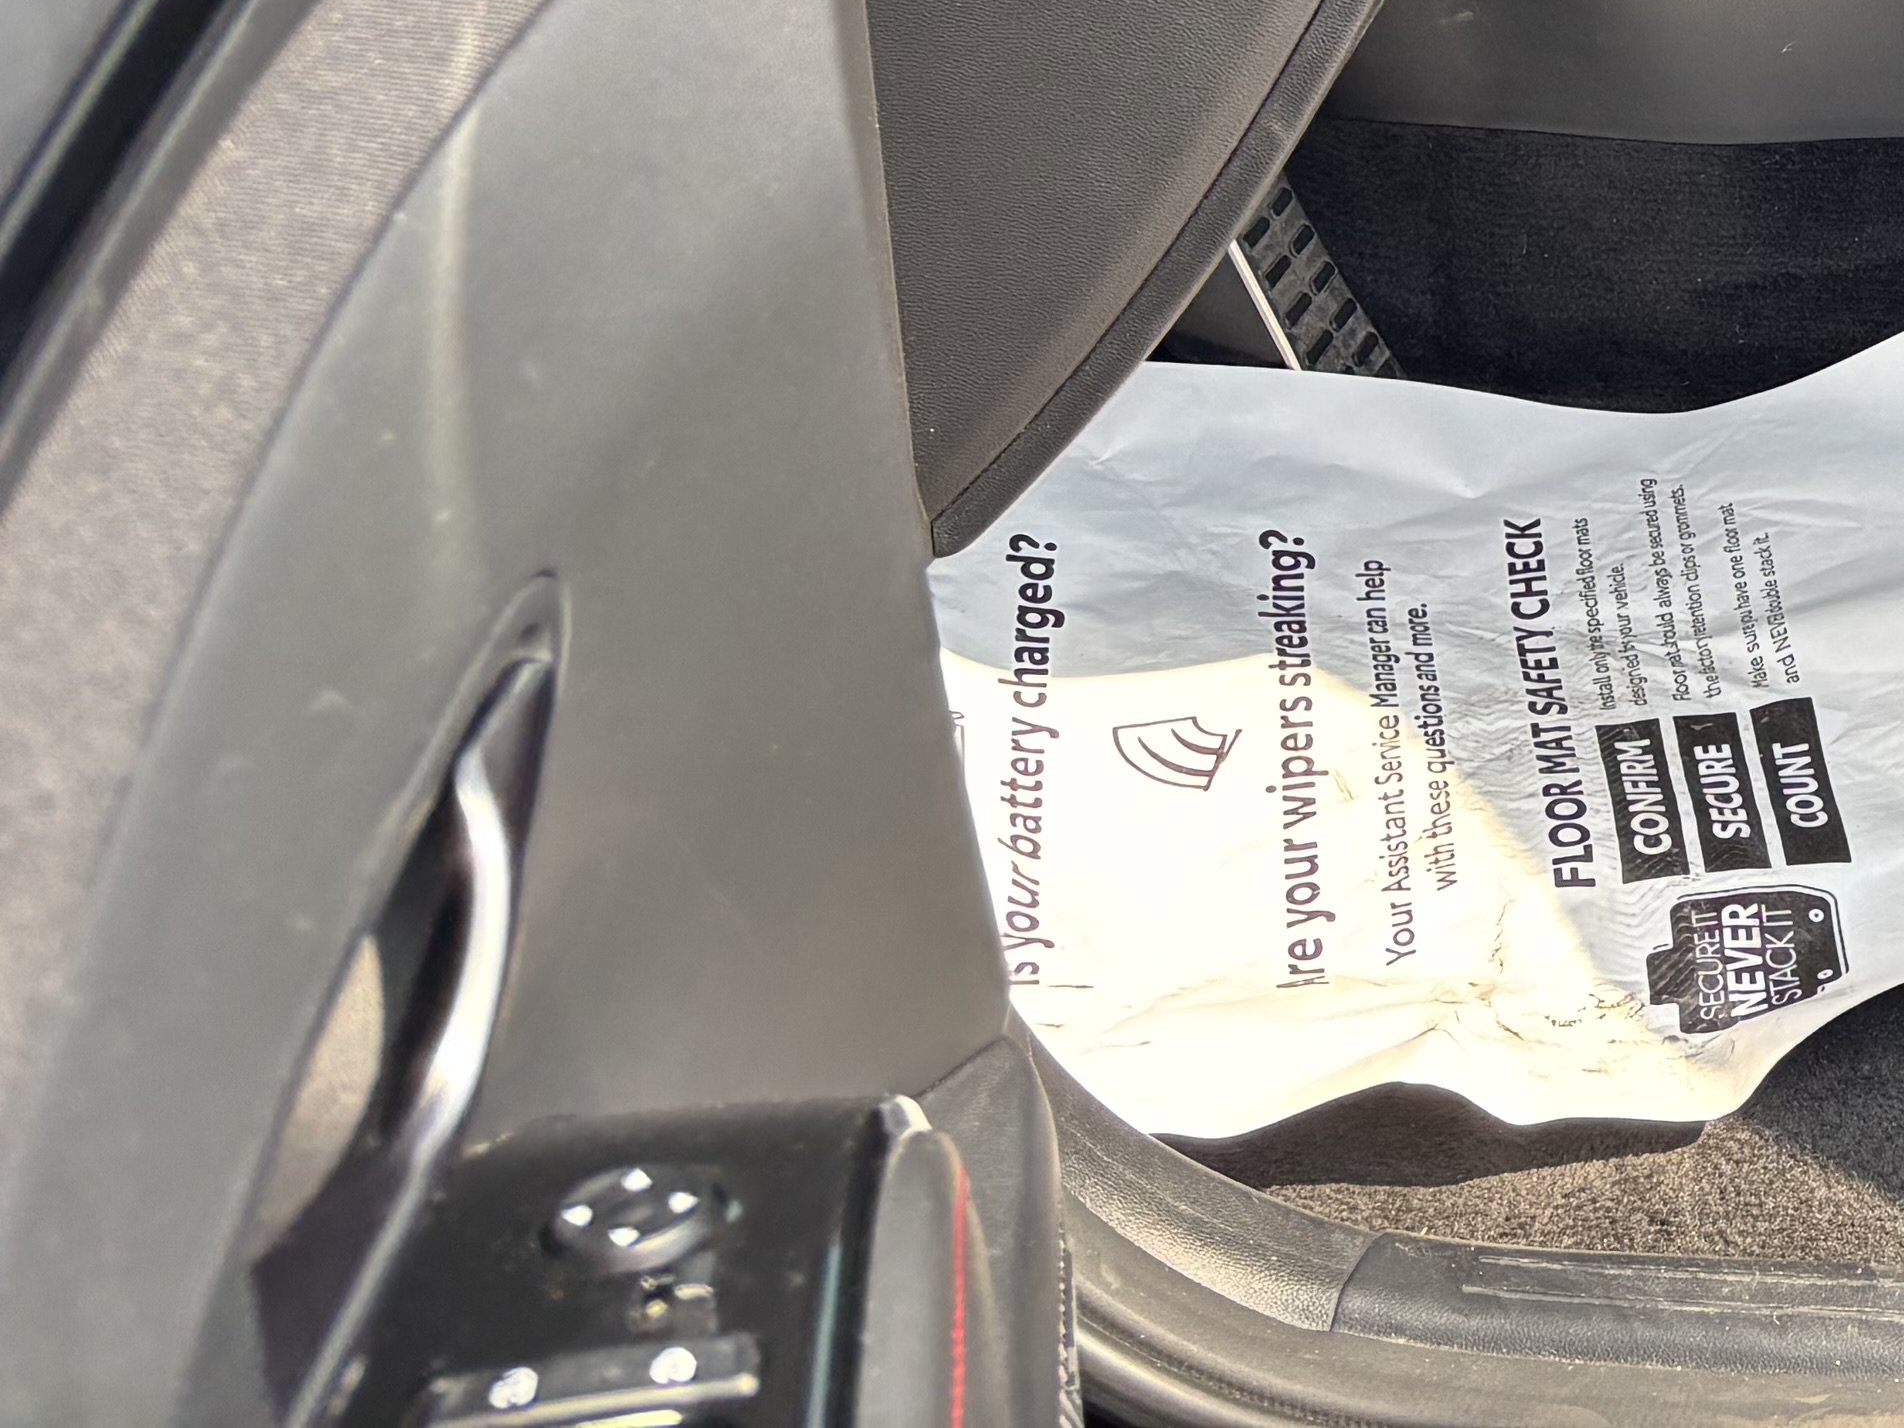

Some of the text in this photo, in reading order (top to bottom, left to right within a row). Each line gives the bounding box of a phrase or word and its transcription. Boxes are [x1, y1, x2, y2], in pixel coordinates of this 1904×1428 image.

[1637, 476, 1660, 509] using
[1716, 500, 1736, 526] mat
[1569, 516, 1592, 547] mats
[1638, 507, 1664, 551] secured
[1722, 525, 1742, 554] floor
[1574, 546, 1597, 576] floor
[1646, 549, 1667, 568] be
[1729, 553, 1747, 581] one
[1752, 544, 1777, 578] stack
[1255, 526, 1316, 689] streaking?
[1573, 573, 1608, 635] specified
[1605, 561, 1630, 611] vehicle.
[1651, 565, 1675, 610] always
[1668, 481, 1723, 700] the factory retention clips or grommets.
[1732, 580, 1753, 611] have
[1760, 577, 1785, 615] double
[995, 531, 1066, 710] charged?
[1740, 622, 1762, 653] sure
[1591, 649, 1618, 675] only
[1620, 652, 1650, 707] designed
[1665, 667, 1693, 703] Floor
[1746, 654, 1770, 690] Make
[1777, 652, 1802, 686] and
[1501, 515, 1598, 890] FLOOR MAT SAFETY CHECK
[1593, 673, 1618, 712] Install
[1263, 694, 1330, 831] wipers
[1353, 558, 1418, 967] Your Assistant Service Manager can help
[1403, 601, 1459, 892] with these questions and more.
[995, 715, 1061, 861] battery
[1612, 737, 1673, 857] CONFIRM
[1692, 742, 1753, 840] SECURE
[1771, 741, 1830, 830] COUNT
[996, 859, 1056, 950] your
[1280, 836, 1337, 930] your
[1690, 908, 1726, 1021] SECURE IT
[1719, 902, 1770, 1018] NEVER
[1759, 903, 1805, 1007] STACK IT
